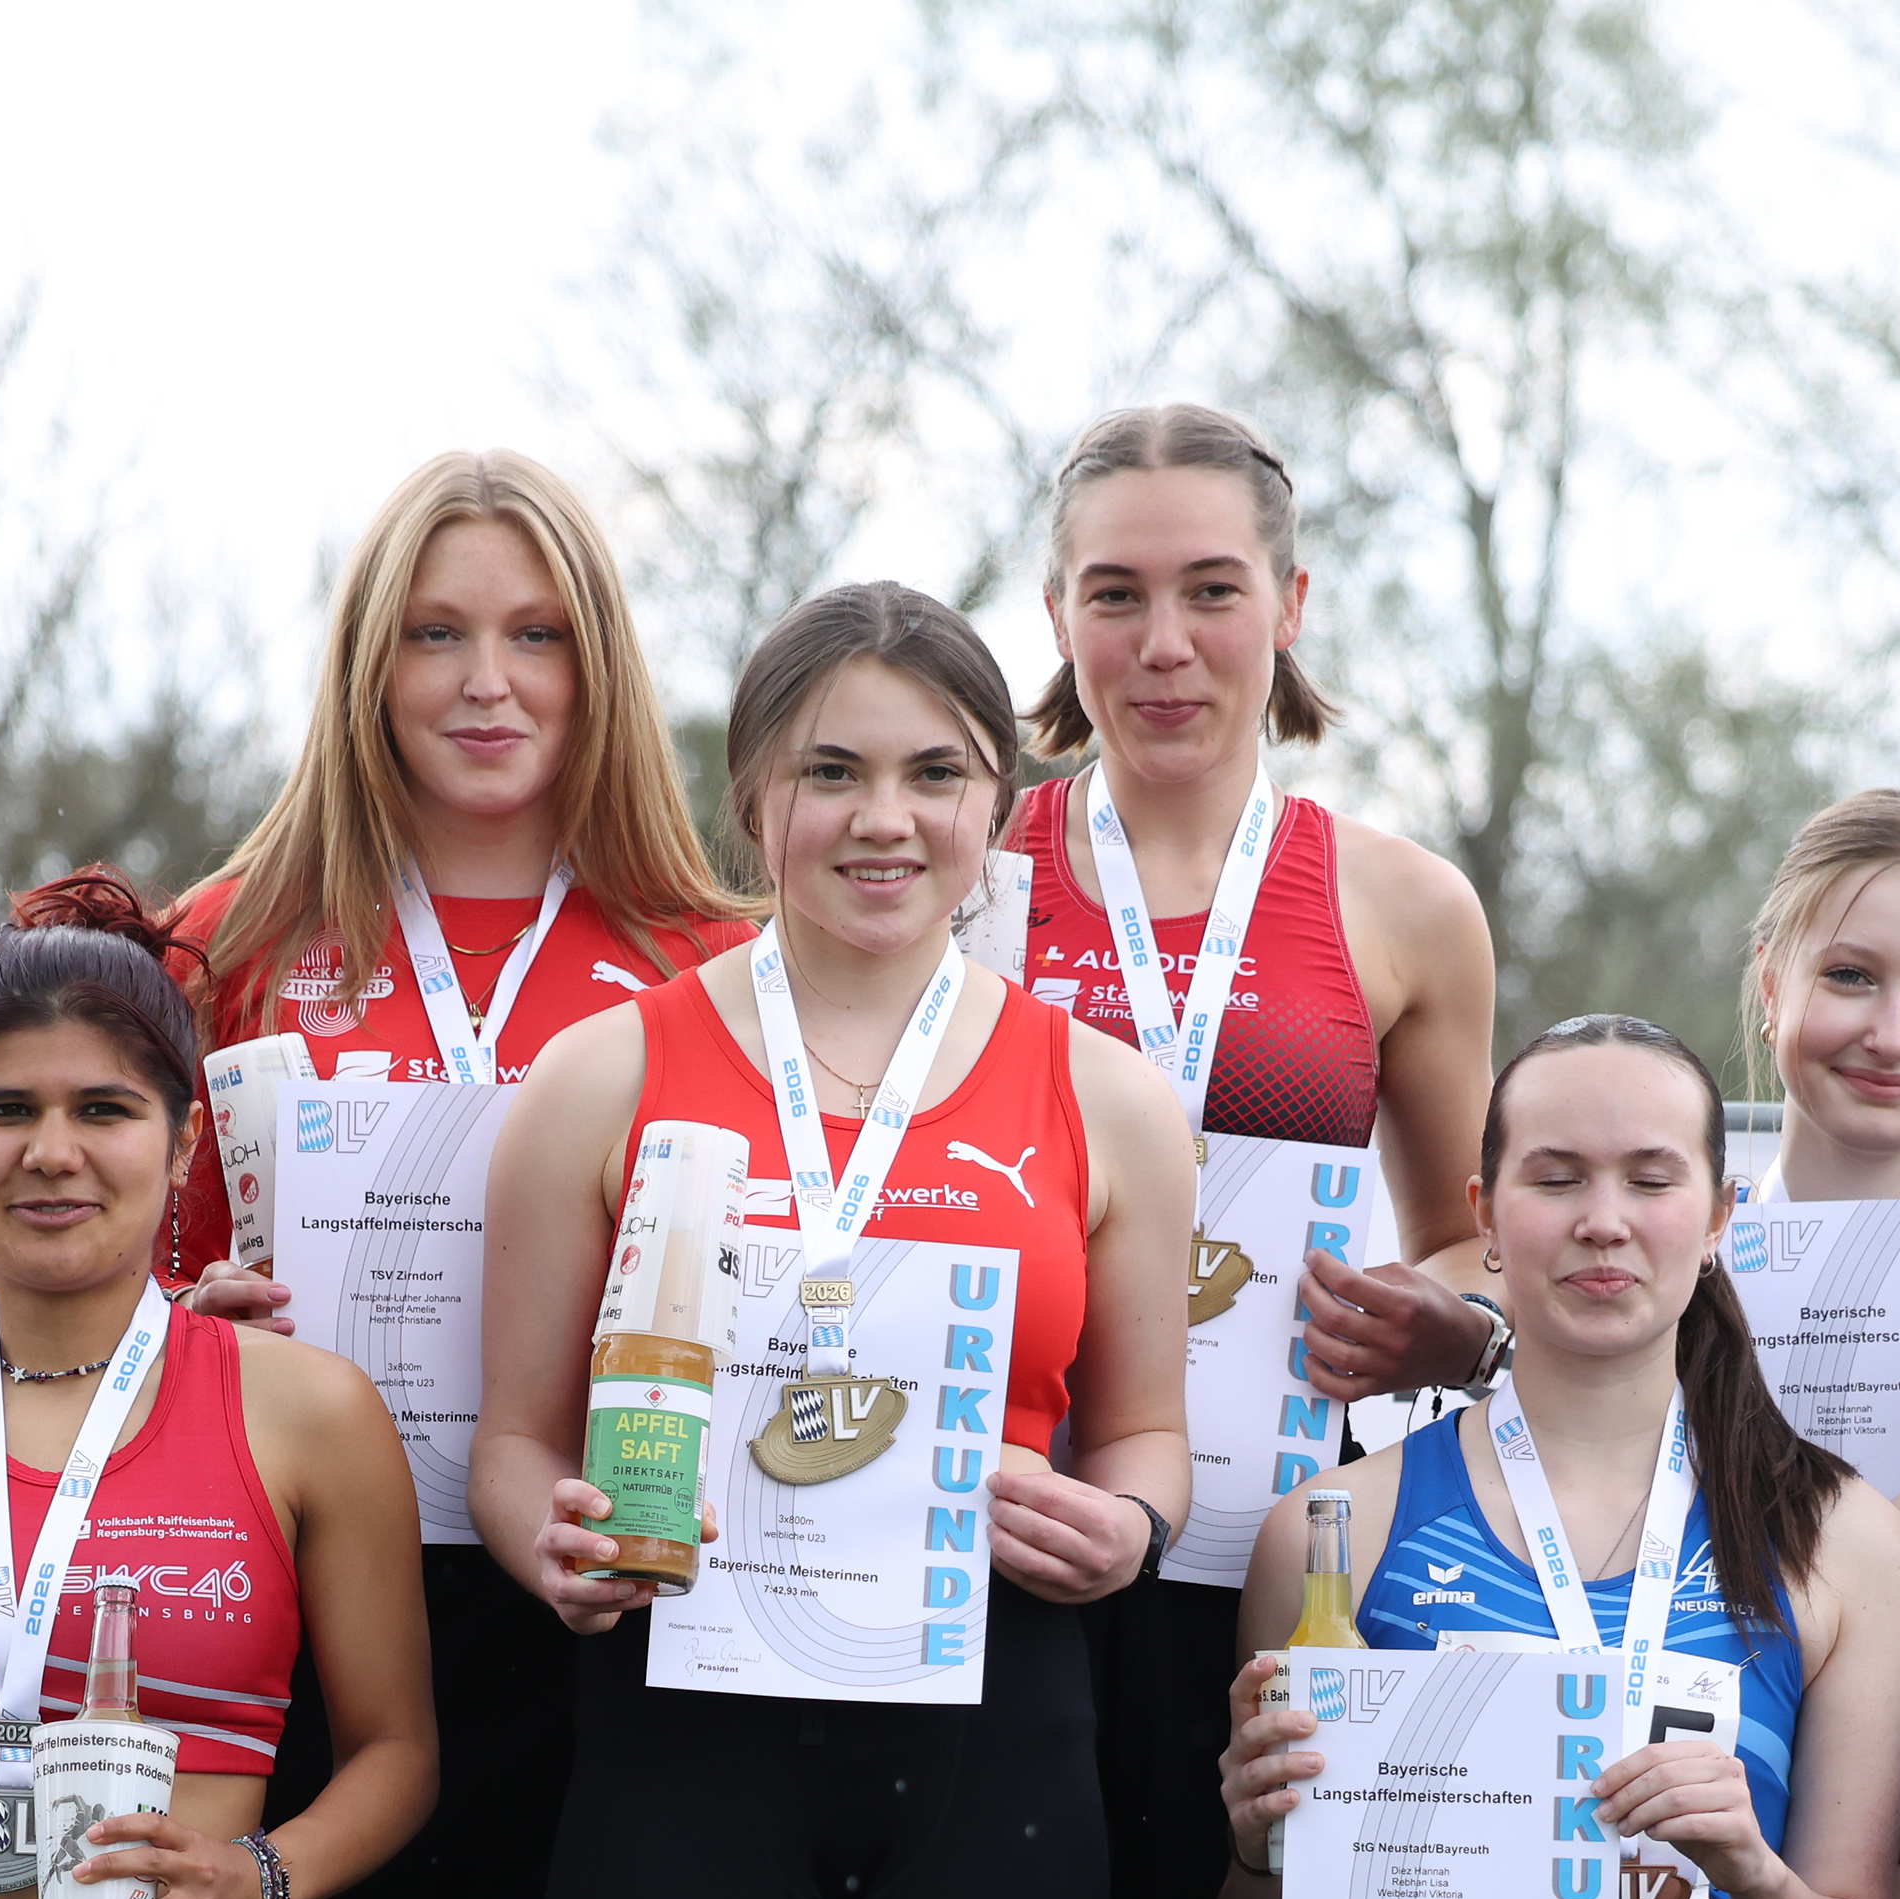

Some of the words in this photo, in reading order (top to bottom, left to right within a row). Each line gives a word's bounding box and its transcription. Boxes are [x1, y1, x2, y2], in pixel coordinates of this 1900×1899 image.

[1240, 800, 1268, 858] 2026
[1121, 906, 1149, 968] 2026
[1072, 949, 1258, 977] AUODC
[290, 966, 331, 979] RACK
[918, 975, 951, 1037] 2026
[1182, 1011, 1208, 1082] 2026
[783, 1057, 808, 1119] 2026
[297, 1101, 389, 1154] BLV
[365, 1191, 451, 1207] Bayerische
[836, 1174, 869, 1233] 2026
[302, 1216, 484, 1233] Langstaffelmeisterscha
[1731, 1220, 1823, 1273] BLV
[370, 1270, 393, 1281] TSV
[395, 1269, 444, 1281] Zirndorf
[350, 1292, 421, 1304] Westphal-Luther
[423, 1292, 462, 1304] Johanna
[804, 1284, 852, 1301] 2026
[406, 1304, 436, 1314] Amelie
[1800, 1305, 1886, 1322] Bayerische
[369, 1315, 396, 1325] Hecht
[399, 1315, 441, 1325] Christiane
[113, 1330, 152, 1393] 2026
[387, 1362, 423, 1373] 3x800m
[373, 1377, 414, 1388] weibliche
[416, 1377, 435, 1388] U23
[1778, 1383, 1801, 1395] StG
[401, 1410, 478, 1423] Meisterinne
[790, 1383, 885, 1443] BLV
[614, 1410, 689, 1439] APFEL
[413, 1432, 430, 1442] min
[1495, 1415, 1535, 1462] BLV
[621, 1438, 682, 1463] SAFT
[612, 1465, 684, 1481] DIREKTSAFT
[920, 1263, 1001, 1666] URKUNDE
[622, 1481, 673, 1496] NATURTRÜB
[97, 1517, 154, 1528] Volksbank
[157, 1516, 235, 1528] Raiffeisenbank
[778, 1513, 815, 1526] 3x800m
[96, 1528, 233, 1540] Regensburg-Schwandorf
[235, 1531, 248, 1541] eG
[764, 1529, 806, 1542] weibliche
[808, 1531, 827, 1543] U23
[1538, 1526, 1571, 1590] 2026
[709, 1556, 786, 1579] Bayerische
[790, 1562, 879, 1584] Meisterinnen
[26, 1562, 56, 1636] 2026
[800, 1586, 818, 1598] min
[1412, 1587, 1476, 1607] erima
[55, 1605, 252, 1624] RENSBURG
[1626, 1639, 1649, 1707] 2026
[1309, 1667, 1404, 1724] BLV
[42, 1760, 132, 1777] Bahnmeetings
[1377, 1762, 1468, 1778] Bayerische
[1313, 1787, 1533, 1806] Langstaffelmeisterschaften
[1352, 1842, 1374, 1855] StG
[1378, 1842, 1490, 1857] Neustadt/Bayreuth
[1414, 1867, 1450, 1876] Hannah
[1392, 1877, 1423, 1887] Rebhan
[1426, 1878, 1449, 1888] Lisa
